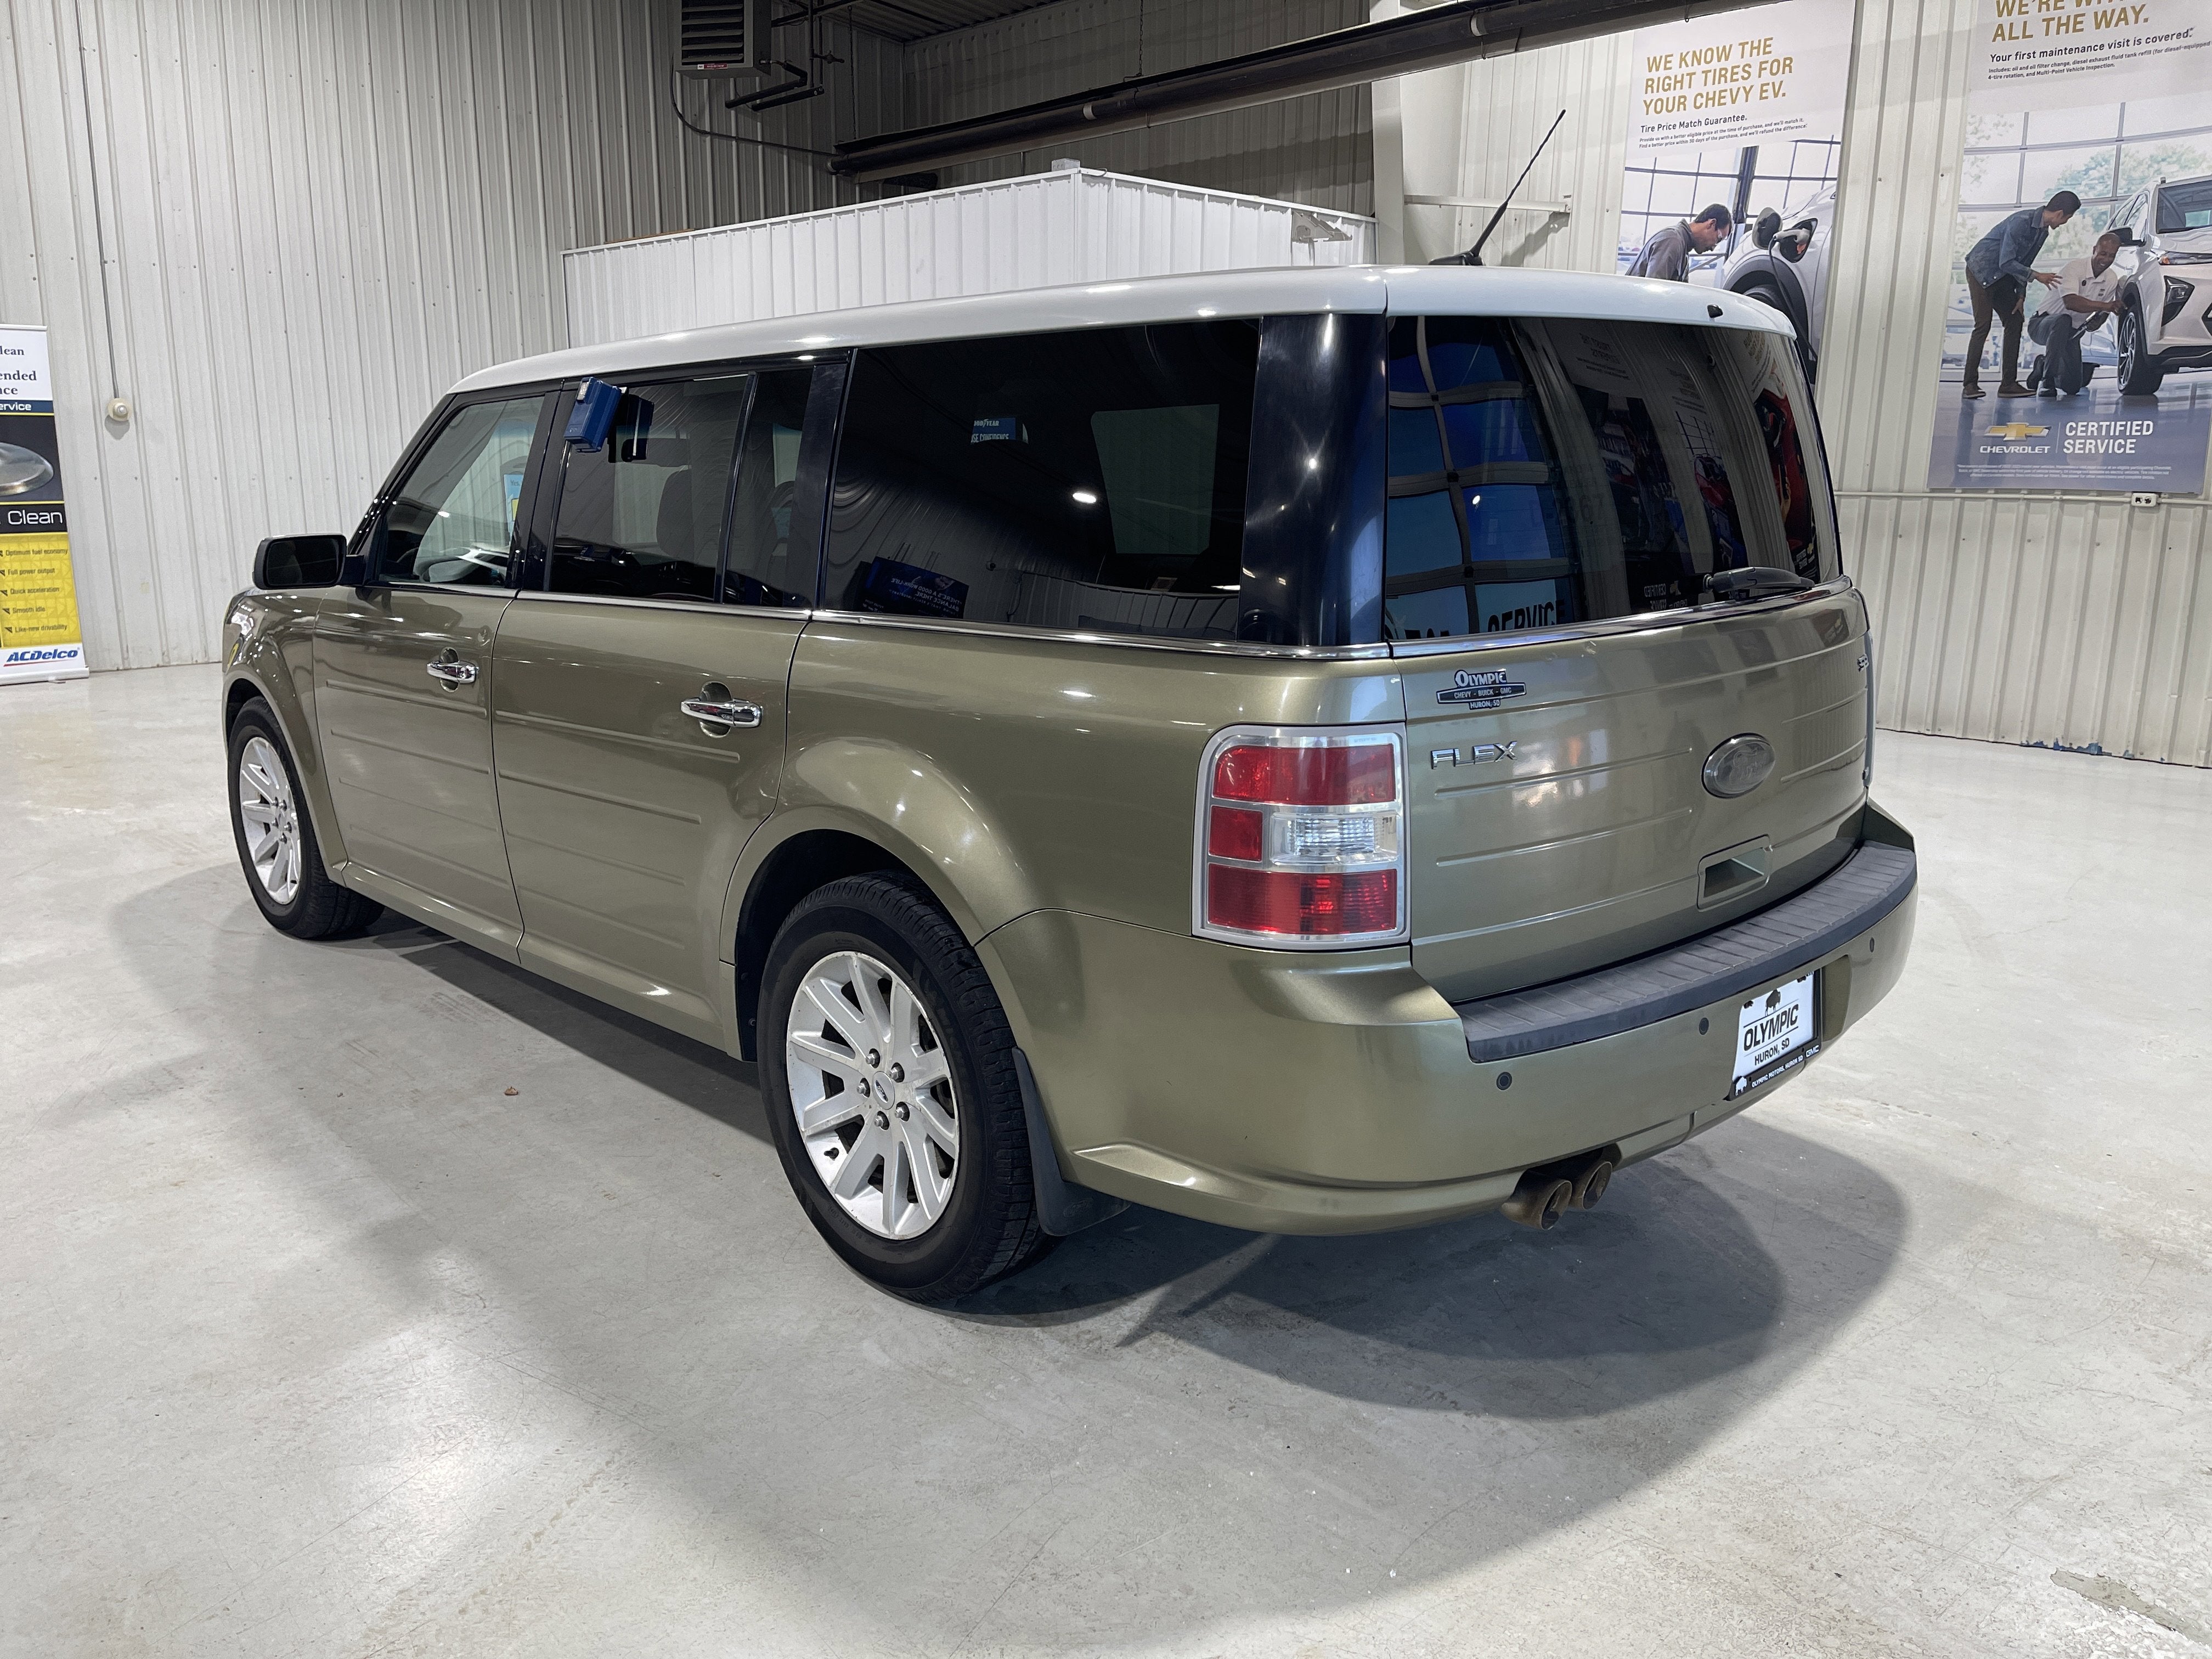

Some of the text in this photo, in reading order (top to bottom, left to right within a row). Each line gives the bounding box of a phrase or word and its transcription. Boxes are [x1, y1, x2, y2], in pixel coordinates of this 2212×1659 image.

[1992, 4, 2149, 42] ALL THE WAY.
[1646, 37, 1774, 72] WE KNOW THE
[1990, 54, 2012, 63] Your
[2015, 50, 2036, 60] first
[2039, 42, 2104, 58] maintenance
[2108, 38, 2130, 50] visit
[2133, 37, 2142, 46] is
[1644, 57, 1794, 95] RIGHT TIRES FOR
[2036, 68, 2065, 76] Multi-Point
[1643, 80, 1786, 115] YOUR CHEVY EV.
[1640, 114, 1747, 133] Tire Price Match Guarantee.
[0, 346, 25, 356] lean
[2065, 420, 2154, 437] CERTIFIED
[1979, 445, 2051, 454] CHEVROLET
[2063, 439, 2136, 454] SERVICE
[8, 509, 63, 525] Clean
[7, 649, 78, 662] ACDelco
[1454, 691, 1471, 699] CHEVY
[1478, 689, 1494, 697] BUICK
[1470, 700, 1492, 709] HURON,
[1431, 741, 1517, 769] FLEX
[1743, 1003, 1799, 1051] OLYMPIC
[1754, 1038, 1790, 1065] HURON, SD
[1805, 1045, 1819, 1057] GMC
[1751, 1074, 1768, 1087] OLYMPIC
